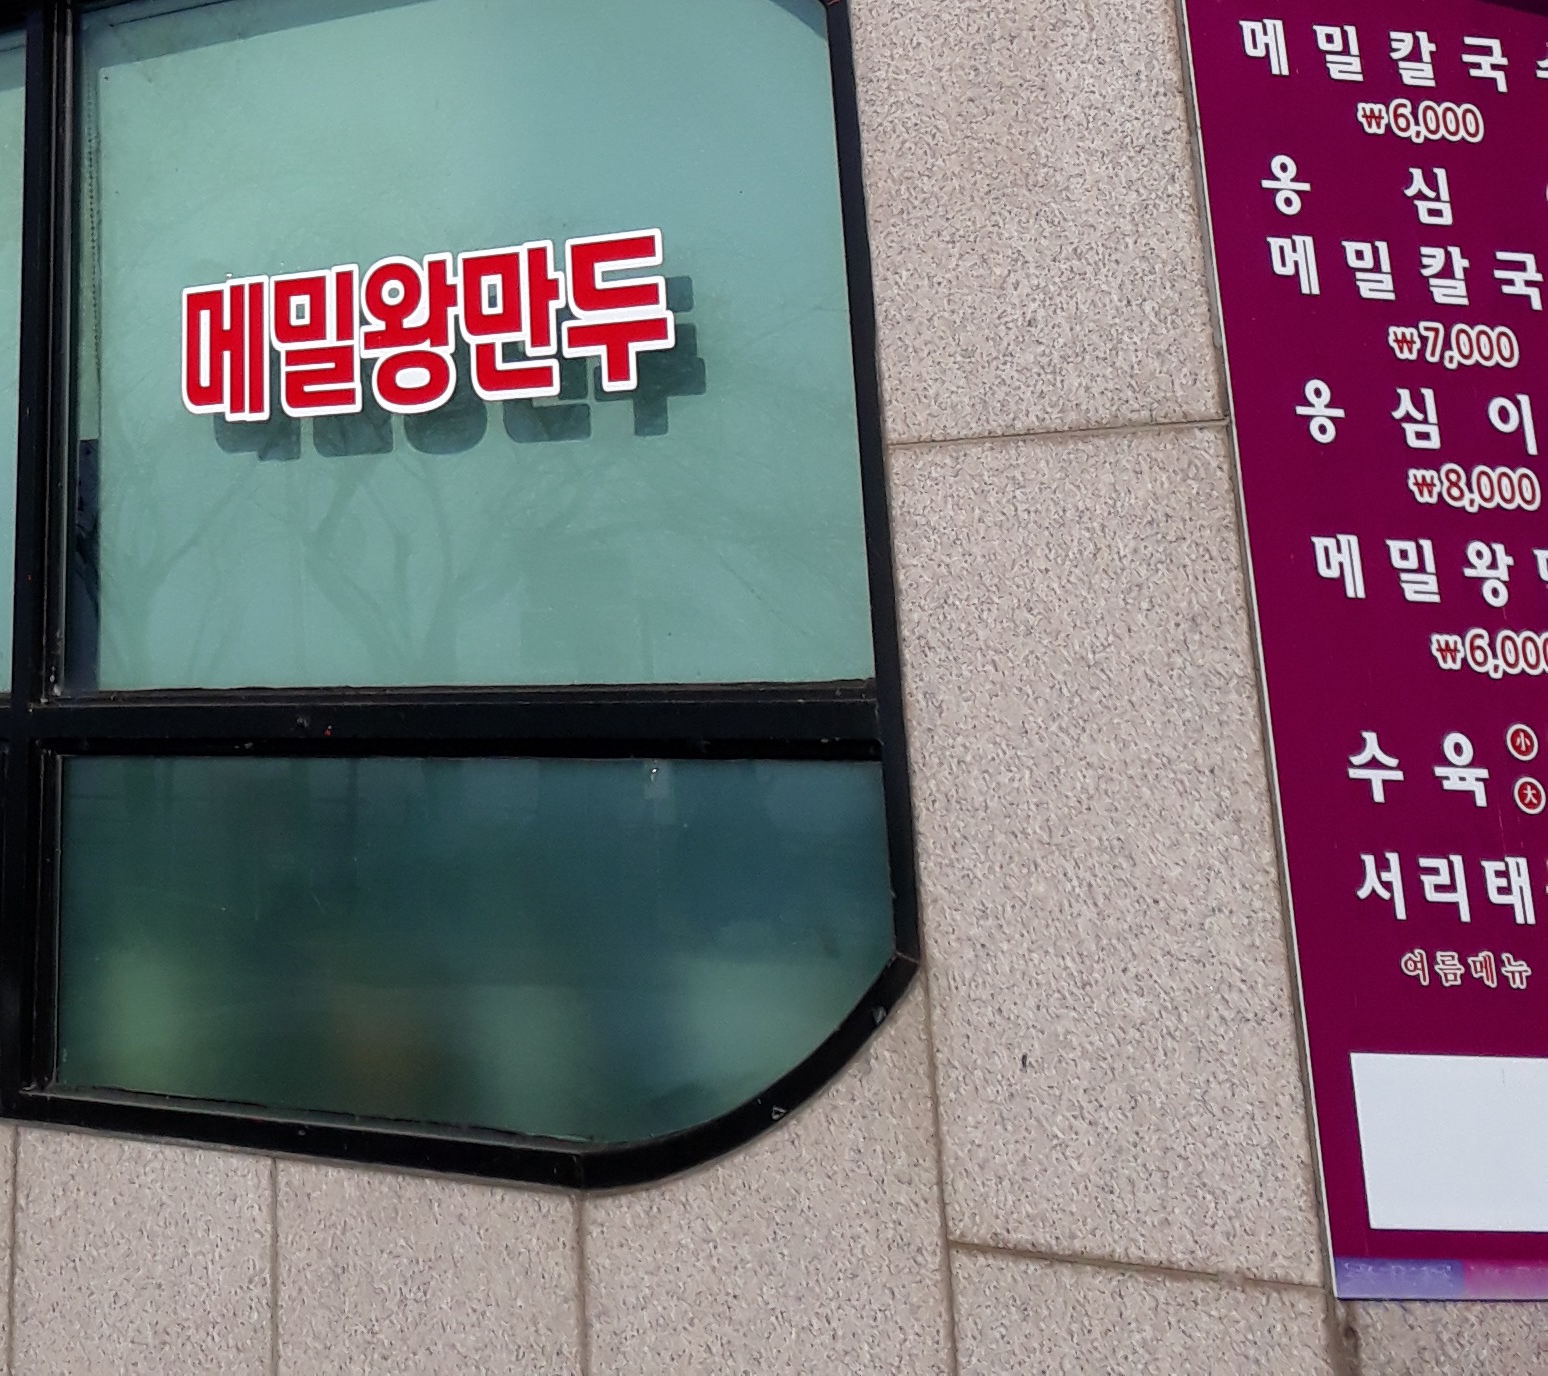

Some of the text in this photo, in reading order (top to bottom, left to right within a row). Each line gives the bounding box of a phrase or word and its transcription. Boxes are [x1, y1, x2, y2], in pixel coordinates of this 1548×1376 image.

[1239, 18, 1548, 94] 메밀칼국
[181, 227, 677, 422] 메밀왕만두
[1310, 532, 1548, 608] 메밀왕
[1356, 851, 1548, 925] 서리태
[1401, 949, 1532, 990] 여름메뉴
